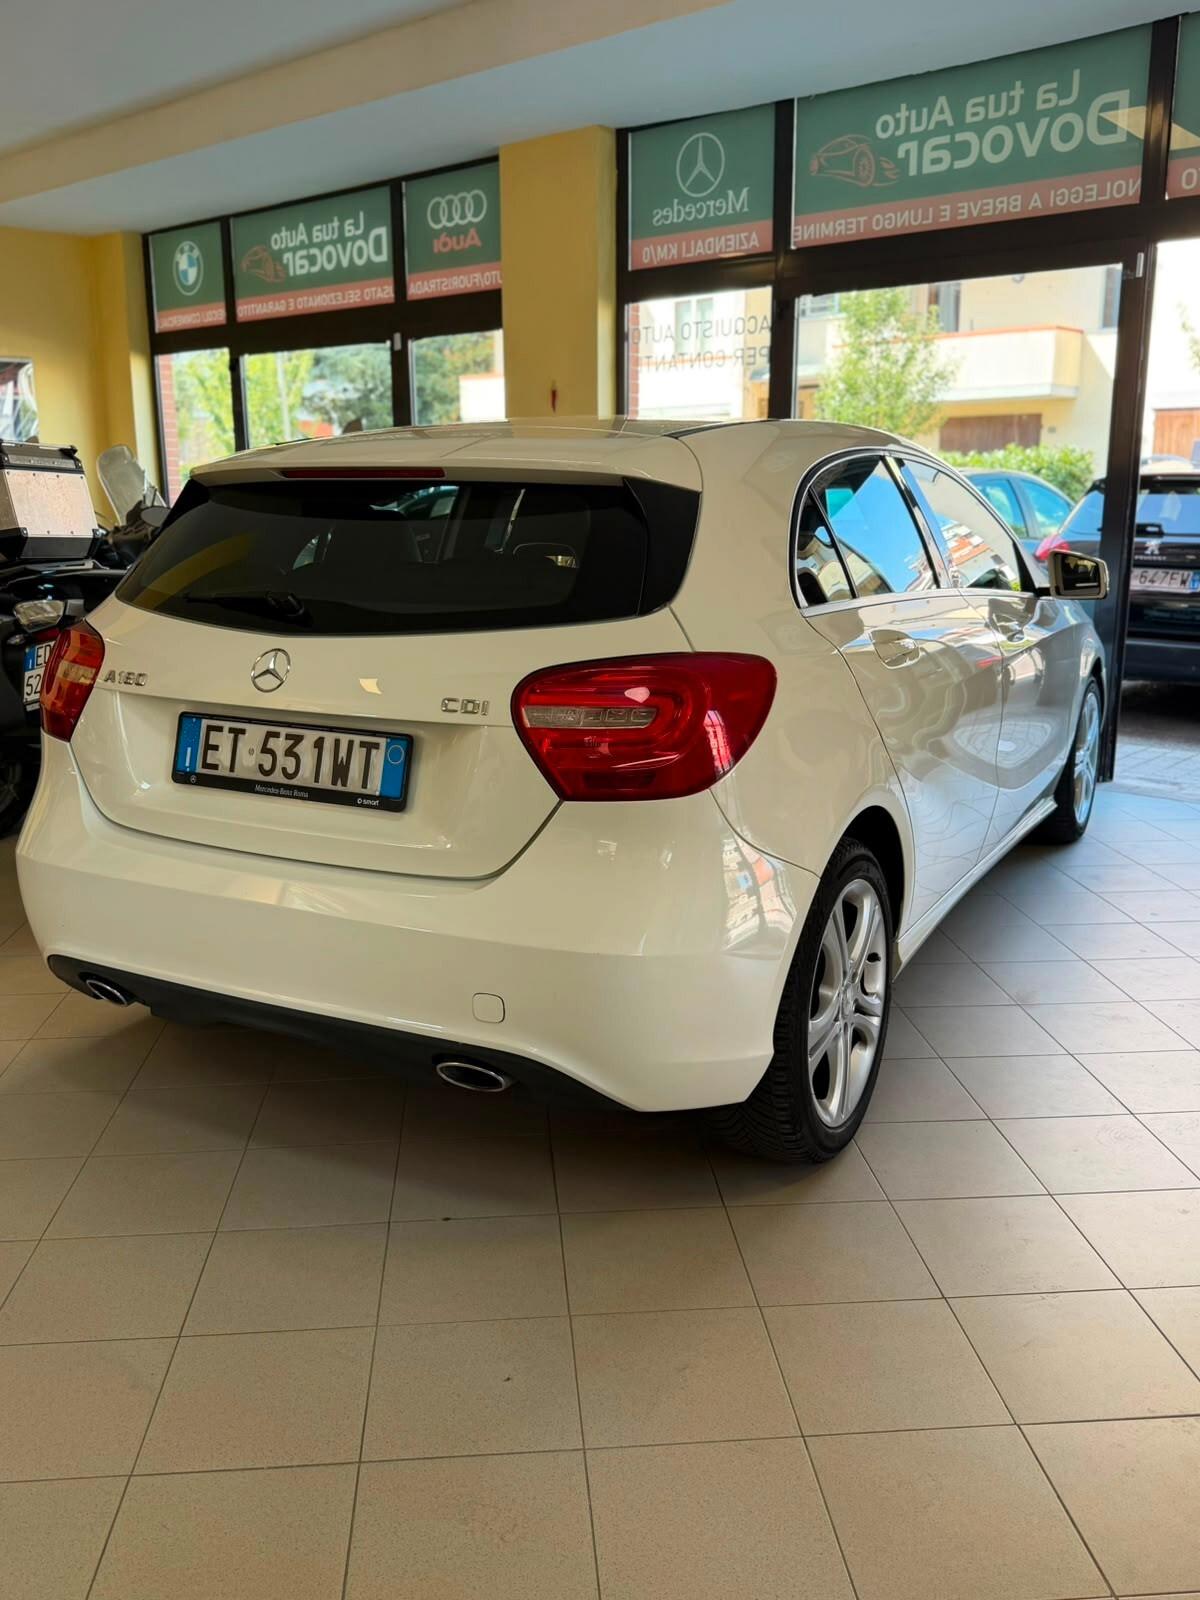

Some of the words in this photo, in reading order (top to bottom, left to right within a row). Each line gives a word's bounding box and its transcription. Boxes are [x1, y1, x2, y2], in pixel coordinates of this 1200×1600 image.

[441, 697, 489, 716] CDI
[202, 724, 247, 773] ET
[258, 731, 381, 790] 531WT
[362, 799, 379, 807] smart
